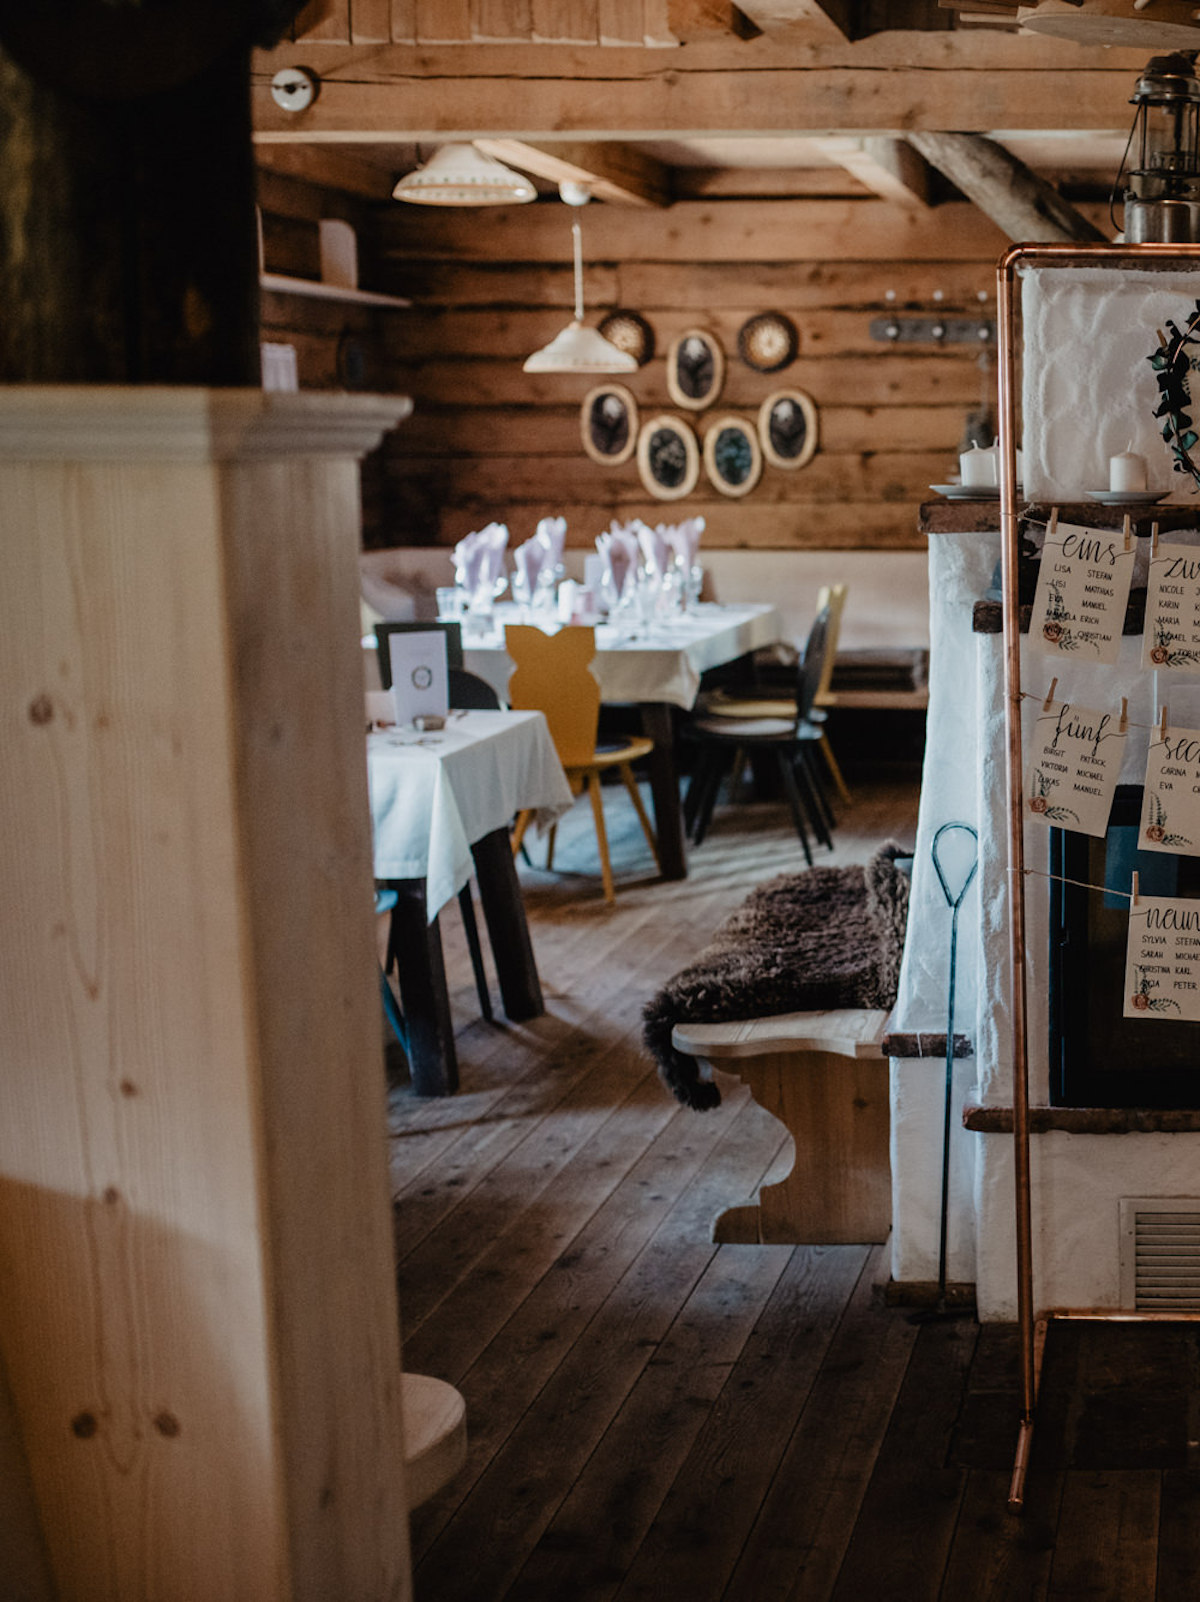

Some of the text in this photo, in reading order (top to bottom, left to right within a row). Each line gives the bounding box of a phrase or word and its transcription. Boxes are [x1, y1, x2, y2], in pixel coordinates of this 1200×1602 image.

[1045, 531, 1135, 565] eins
[1054, 563, 1113, 581] LISA STEFAN
[1085, 585, 1114, 597] MATTHIAS
[1159, 585, 1185, 595] NICOLE
[1081, 600, 1107, 611] MANUEL
[1158, 600, 1179, 609] KARIN
[1080, 615, 1100, 625] ERICH
[1157, 616, 1180, 625] MARIA
[1077, 630, 1112, 642] CHRISTIAN
[1037, 703, 1127, 757] fünf
[1043, 746, 1107, 768] BIRGIT PATRICK
[1041, 760, 1105, 782] VIKTORIA MICHAEL
[1160, 766, 1187, 777] CARINA
[1073, 783, 1104, 797] MANUEL
[1160, 781, 1174, 790] EVA
[1141, 934, 1167, 945] SYLVIA
[1140, 949, 1164, 958] SARAH
[1174, 966, 1193, 975] KARL
[1173, 981, 1198, 990] PETER
